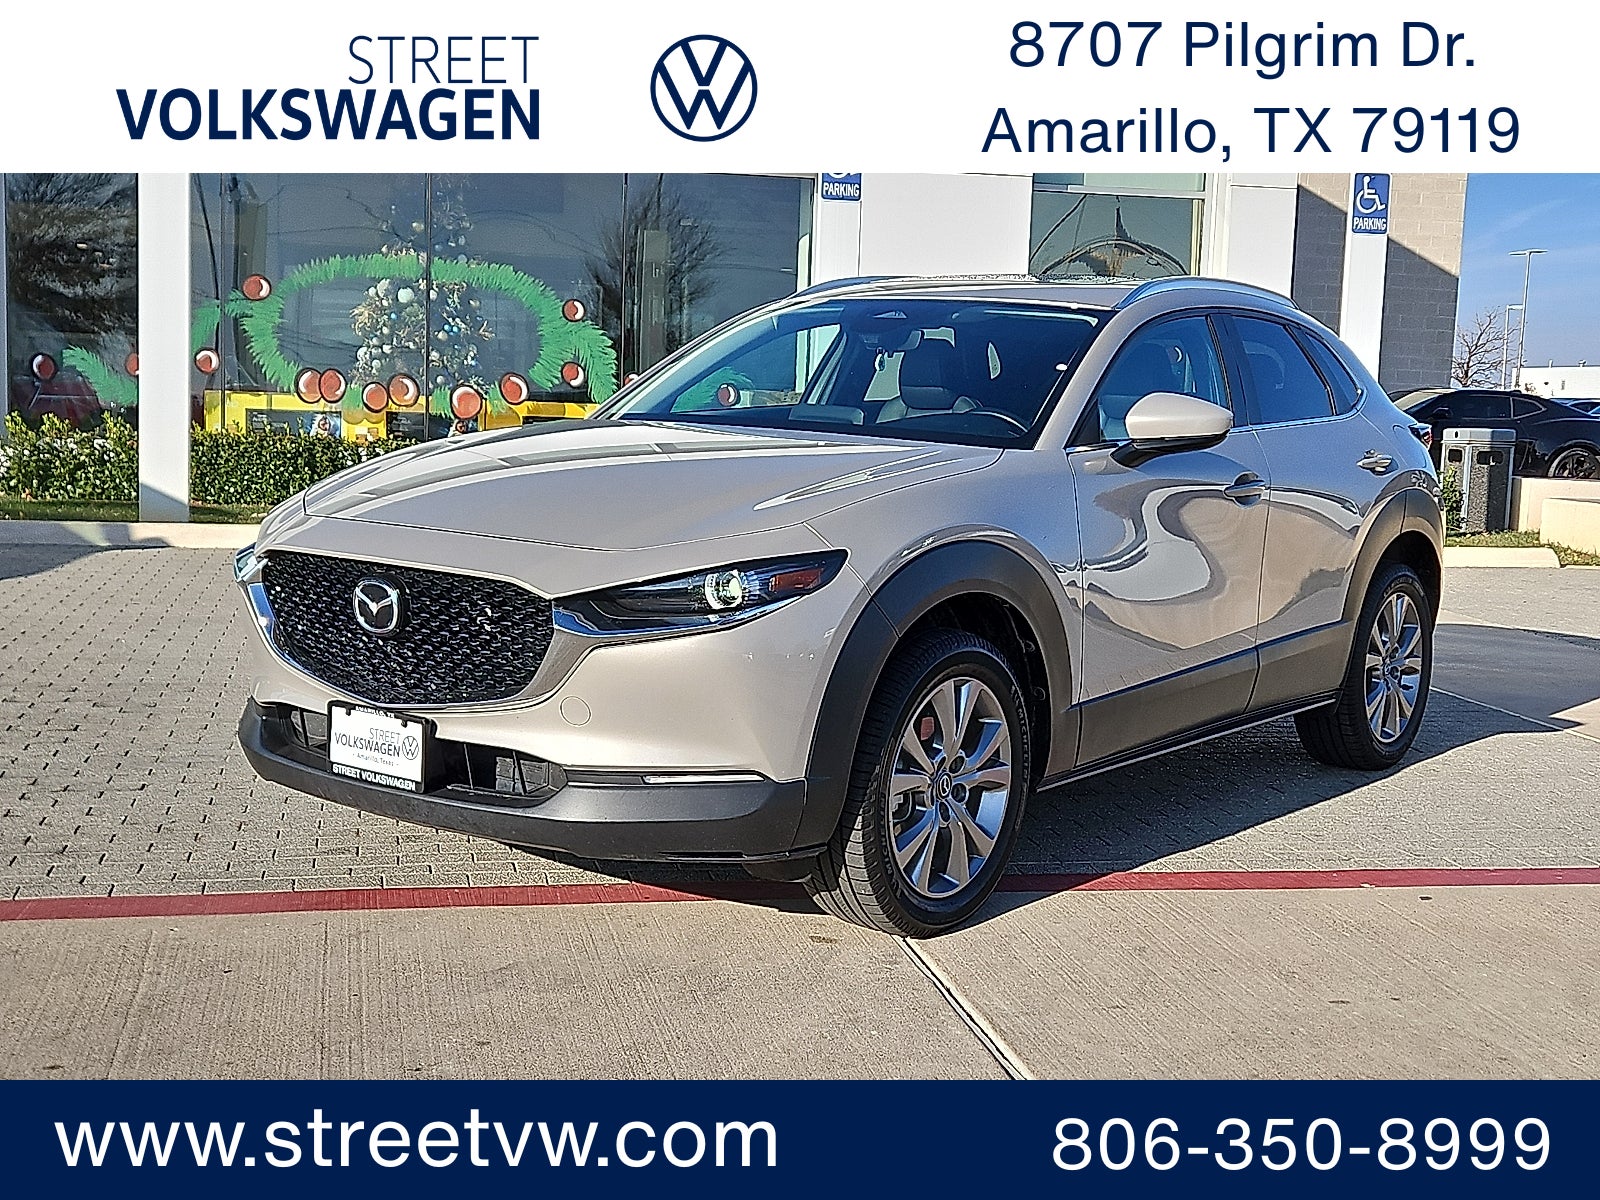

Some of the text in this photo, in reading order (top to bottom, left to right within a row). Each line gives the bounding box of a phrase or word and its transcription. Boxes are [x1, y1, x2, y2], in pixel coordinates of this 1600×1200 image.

[823, 182, 860, 197] PARKING
[1353, 216, 1387, 231] PARKING
[334, 731, 401, 758] VOLKSWAGEN
[369, 727, 401, 745] STREET
[332, 763, 416, 792] STREET VOLKSWAGEN
